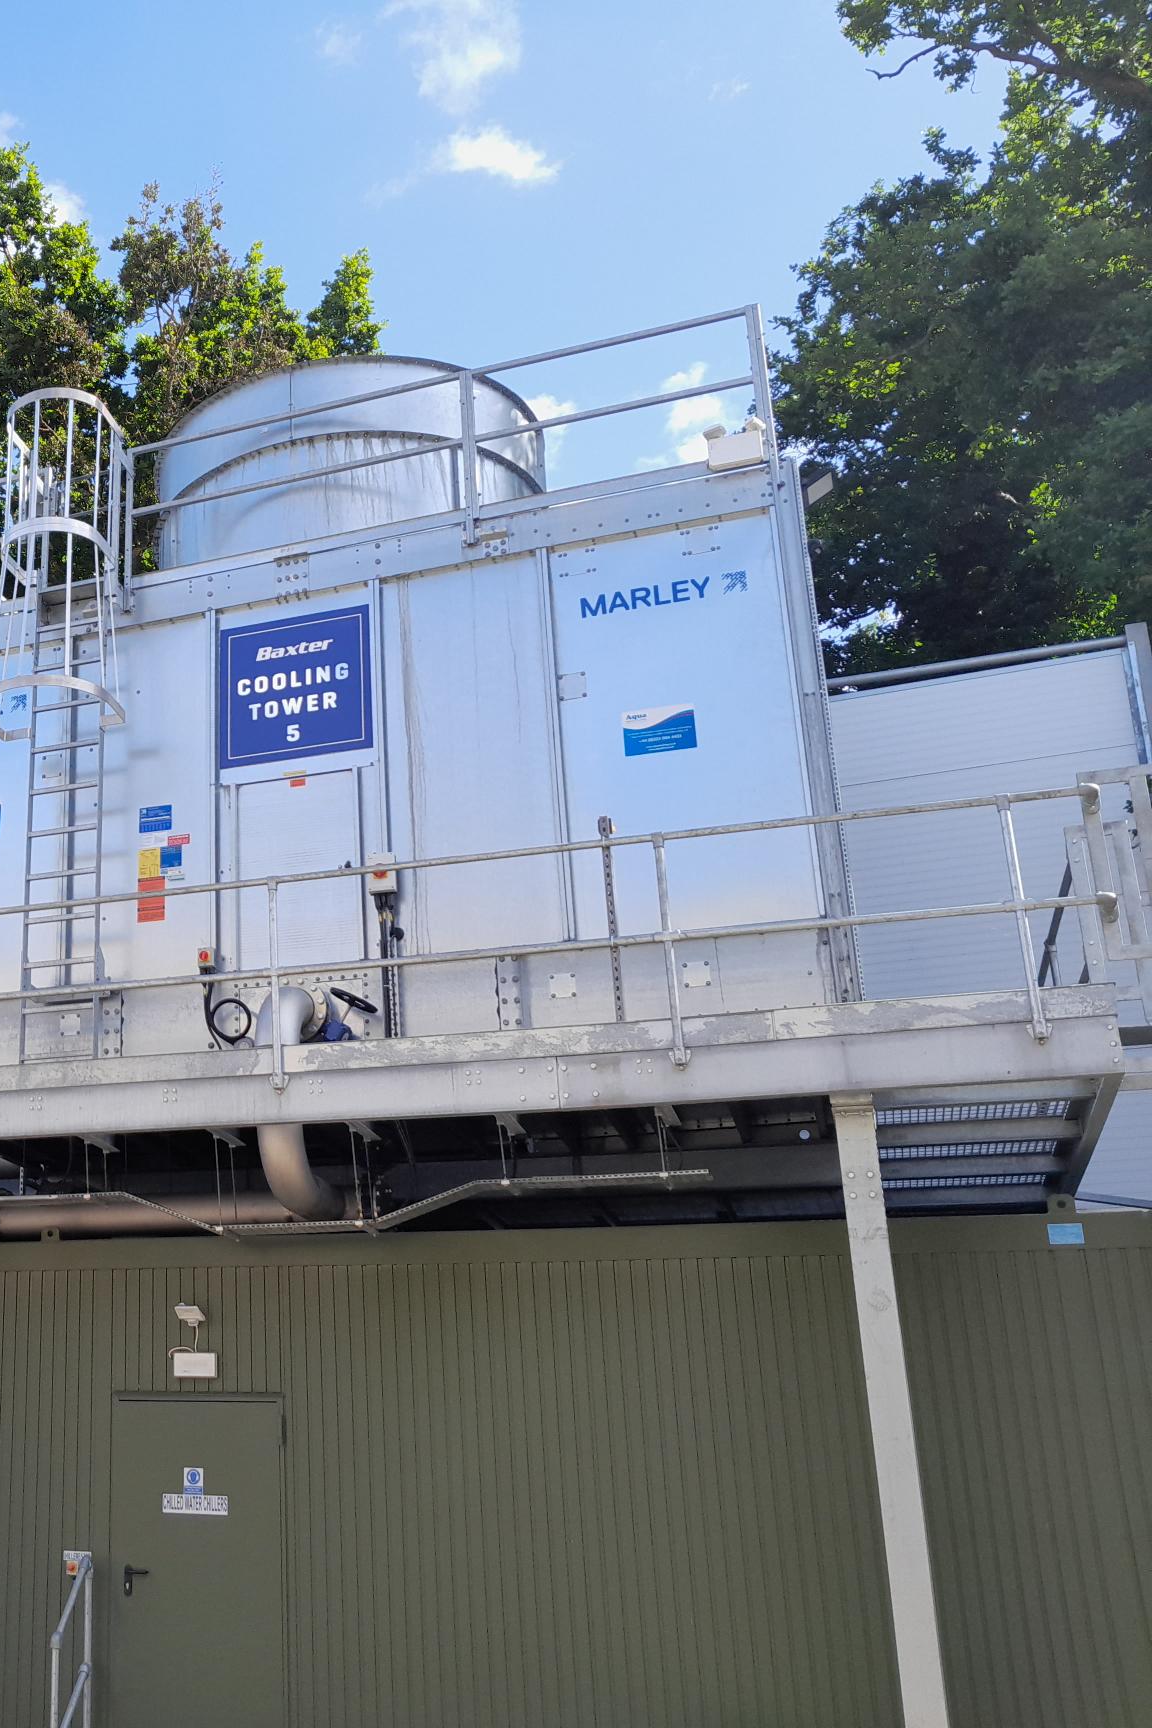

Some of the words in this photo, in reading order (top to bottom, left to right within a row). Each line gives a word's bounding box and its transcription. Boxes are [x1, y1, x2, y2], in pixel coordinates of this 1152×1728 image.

[580, 576, 710, 619] MARLEY
[255, 638, 333, 662] Baxter
[237, 662, 349, 696] COOLING
[248, 691, 337, 721] TOWER
[286, 723, 300, 742] 5
